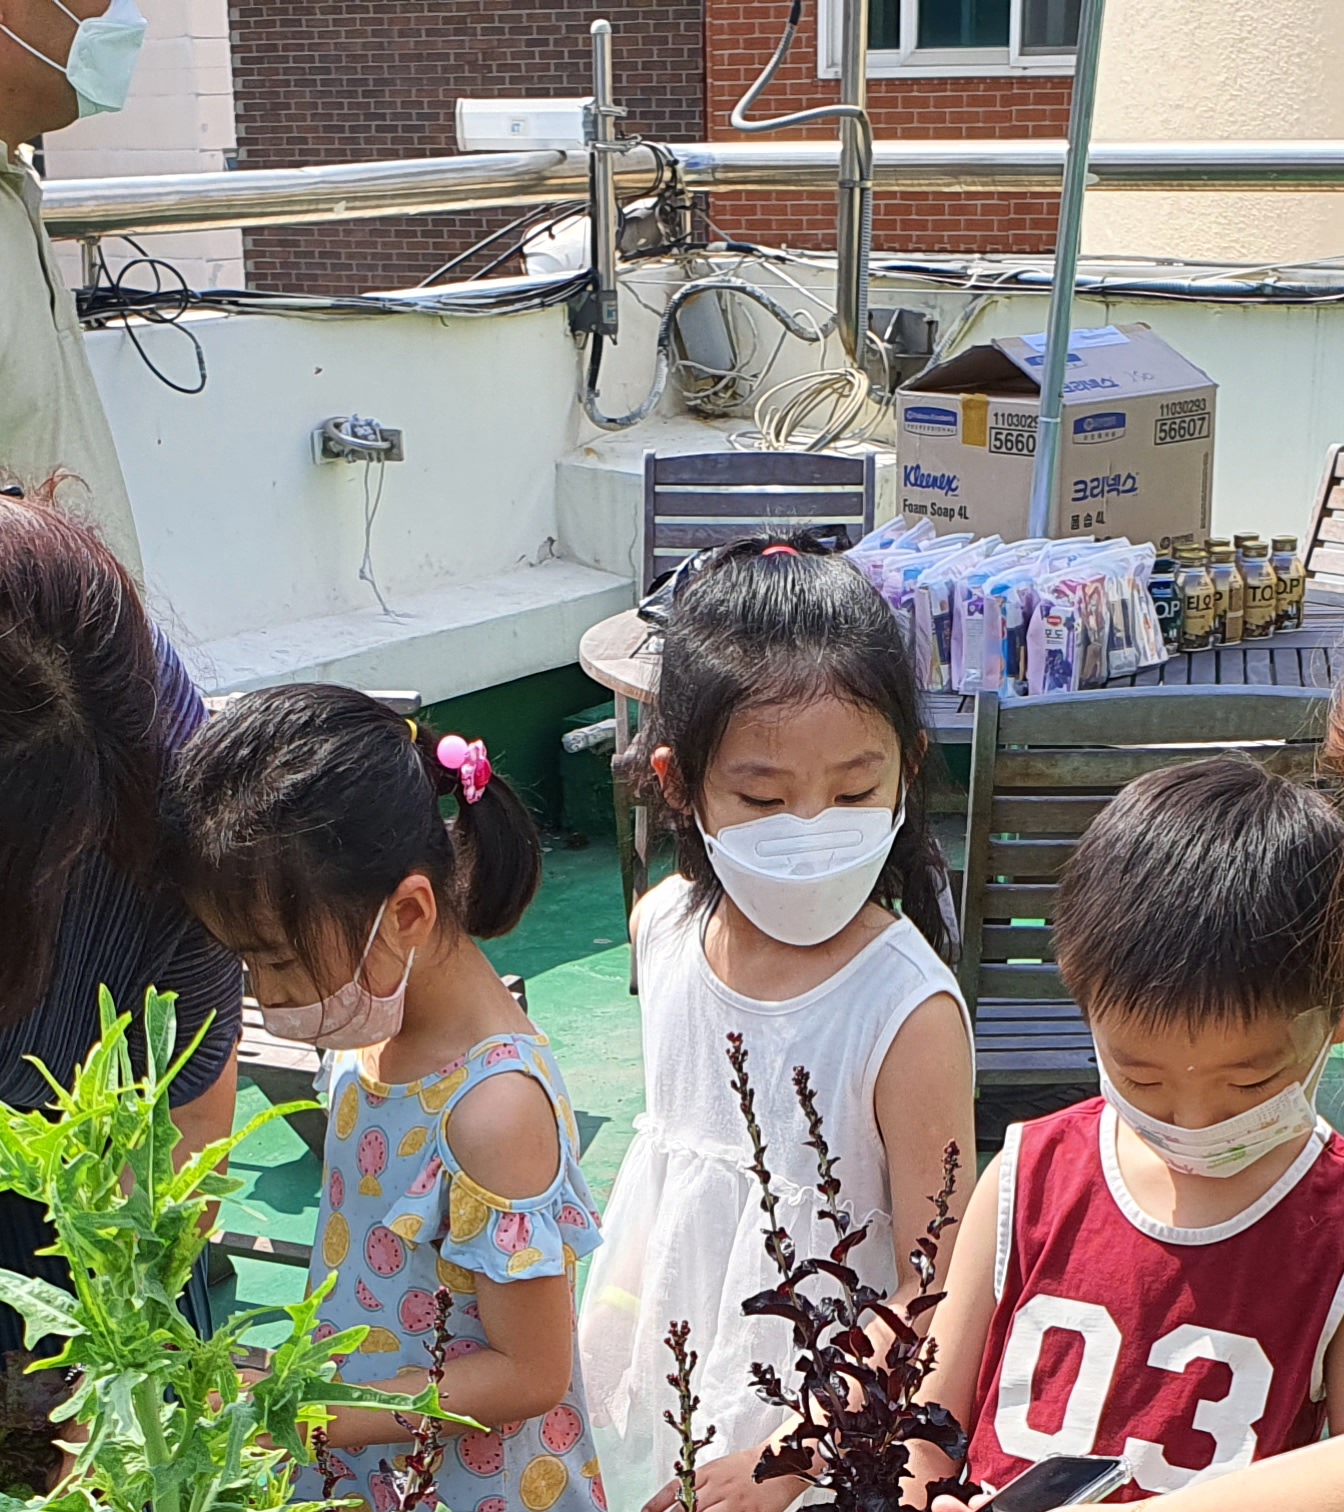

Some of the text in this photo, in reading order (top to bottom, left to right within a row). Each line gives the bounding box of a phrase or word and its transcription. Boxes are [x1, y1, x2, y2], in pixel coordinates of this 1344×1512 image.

[993, 411, 1039, 427] 1103029
[1160, 399, 1206, 417] 11030293
[1159, 417, 1205, 441] 56607
[993, 432, 1035, 453] 5660
[903, 463, 959, 496] Kleenex
[1071, 472, 1138, 502] 크리넥스
[903, 498, 969, 522] Foam Soap 4L
[994, 1293, 1274, 1493] 03
